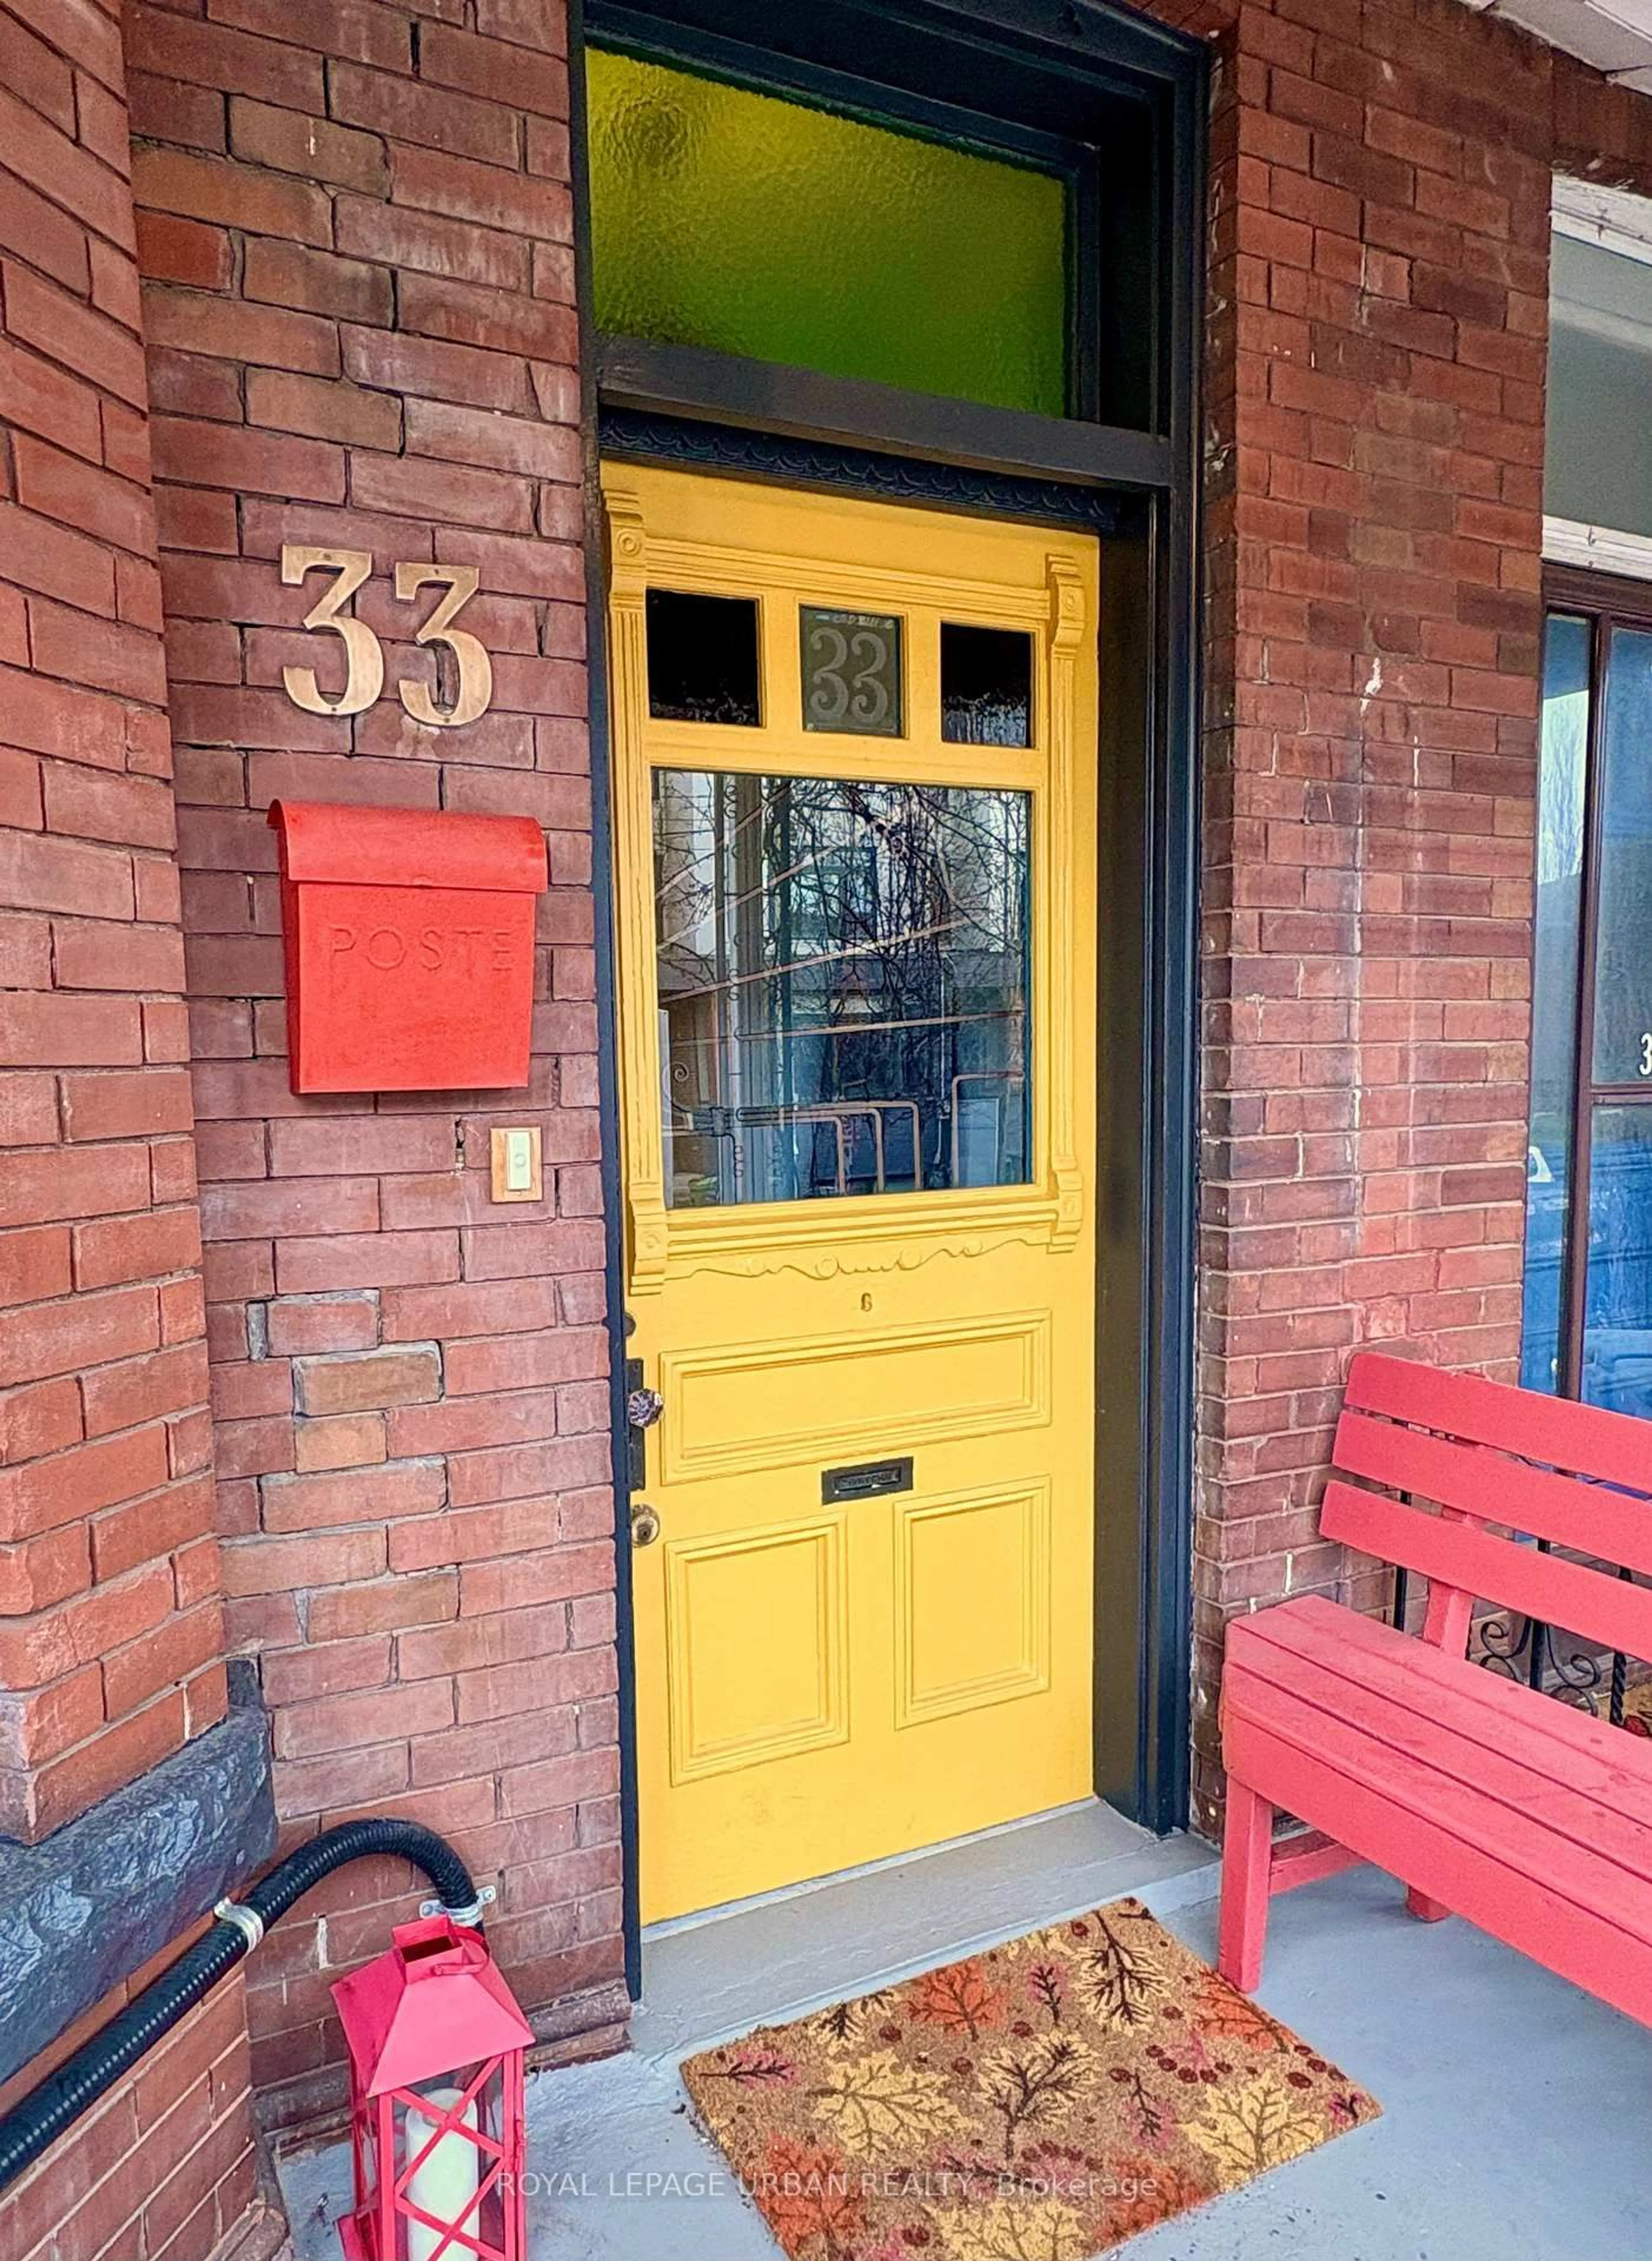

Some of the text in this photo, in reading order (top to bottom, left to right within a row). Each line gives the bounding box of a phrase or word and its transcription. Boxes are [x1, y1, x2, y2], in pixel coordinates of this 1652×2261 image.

[282, 544, 492, 726] 33
[810, 626, 888, 724] 33
[329, 925, 514, 975] POSTE
